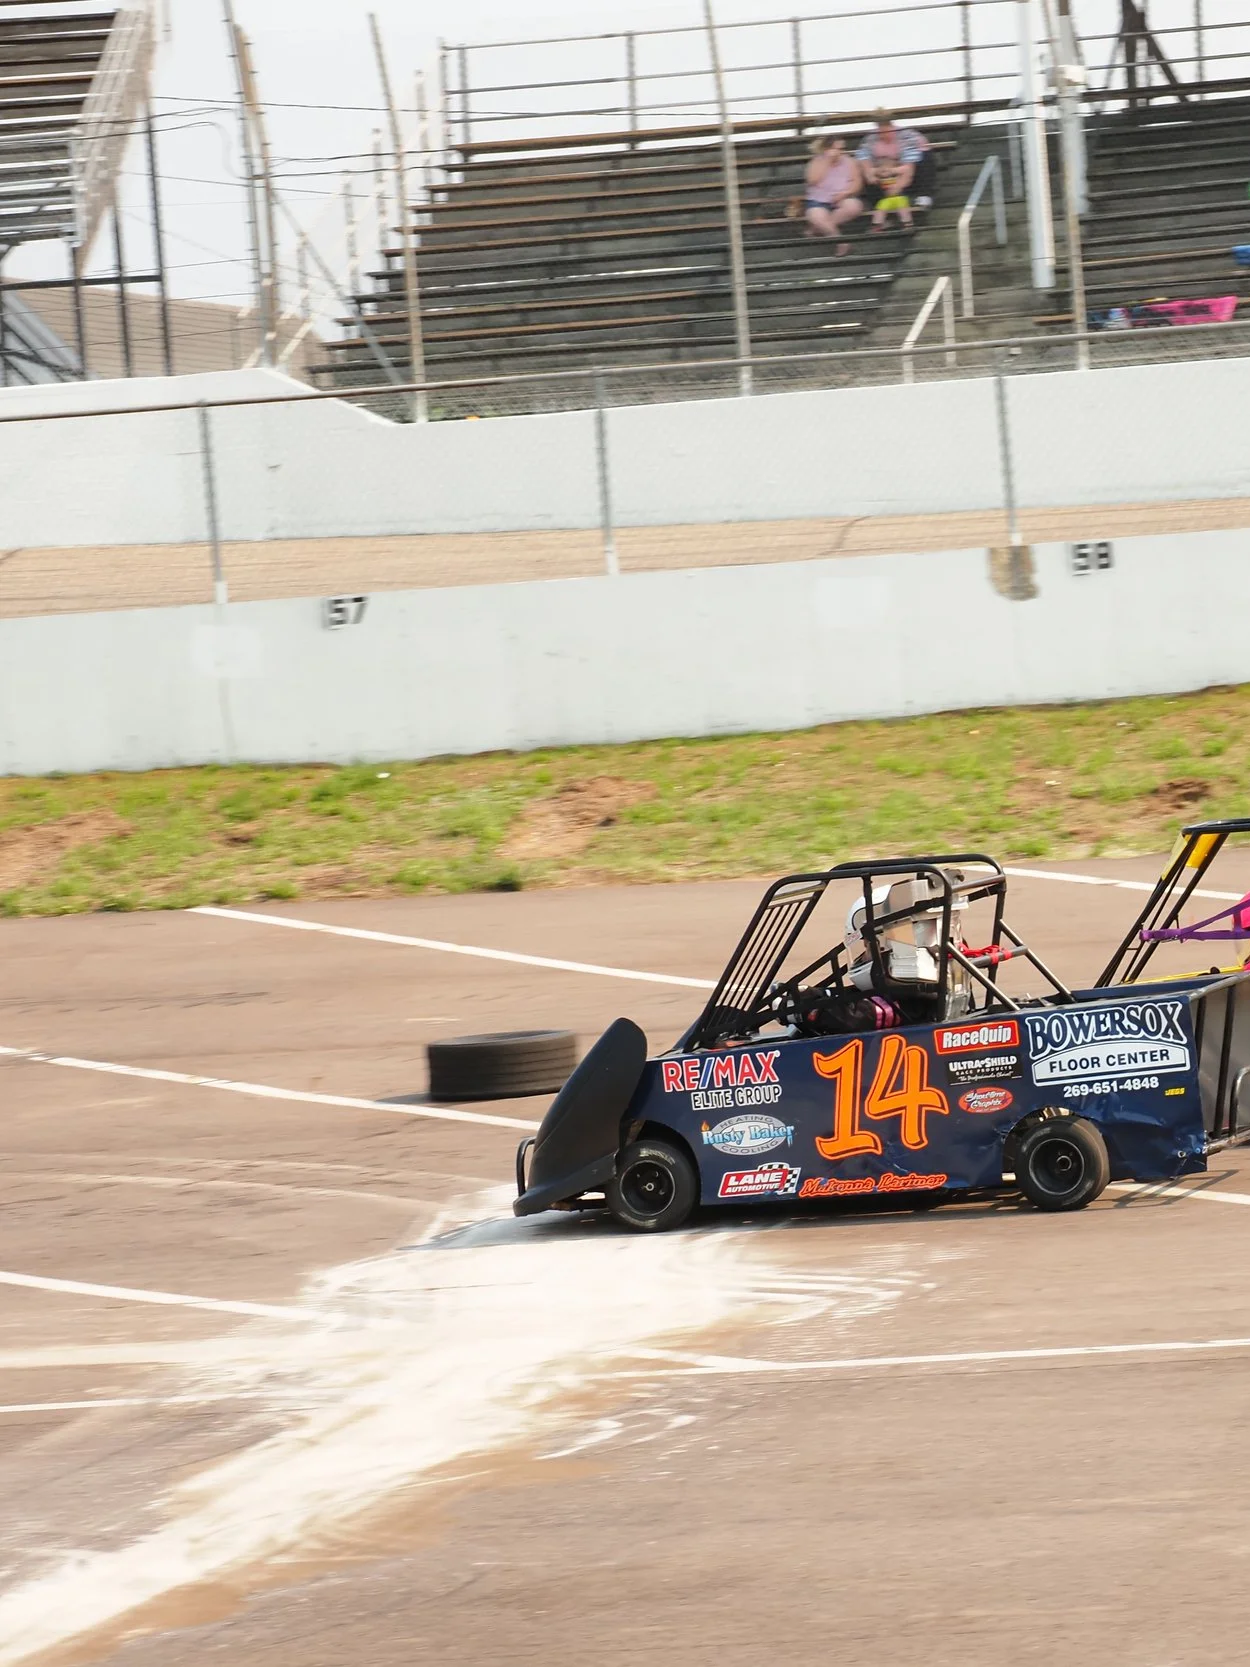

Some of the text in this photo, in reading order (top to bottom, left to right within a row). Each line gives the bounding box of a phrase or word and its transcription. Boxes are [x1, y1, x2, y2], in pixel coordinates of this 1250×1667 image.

[1071, 541, 1114, 575] 58
[323, 596, 369, 628] 57
[942, 1025, 1012, 1049] RaceQuip
[1025, 1001, 1187, 1060] BOWERSOX
[662, 1050, 781, 1092] RE/MAX
[1049, 1049, 1170, 1073] FLOOR CENTER
[691, 1085, 782, 1110] ELITE GROUP
[812, 1034, 950, 1160] 14
[1063, 1076, 1160, 1098] 269-651-4848
[719, 1115, 774, 1129] HEATING
[701, 1123, 795, 1146] Rusty Baker
[721, 1141, 779, 1154] COOLING
[725, 1183, 780, 1194] AUTOMOTIVE
[728, 1171, 783, 1187] LANE
